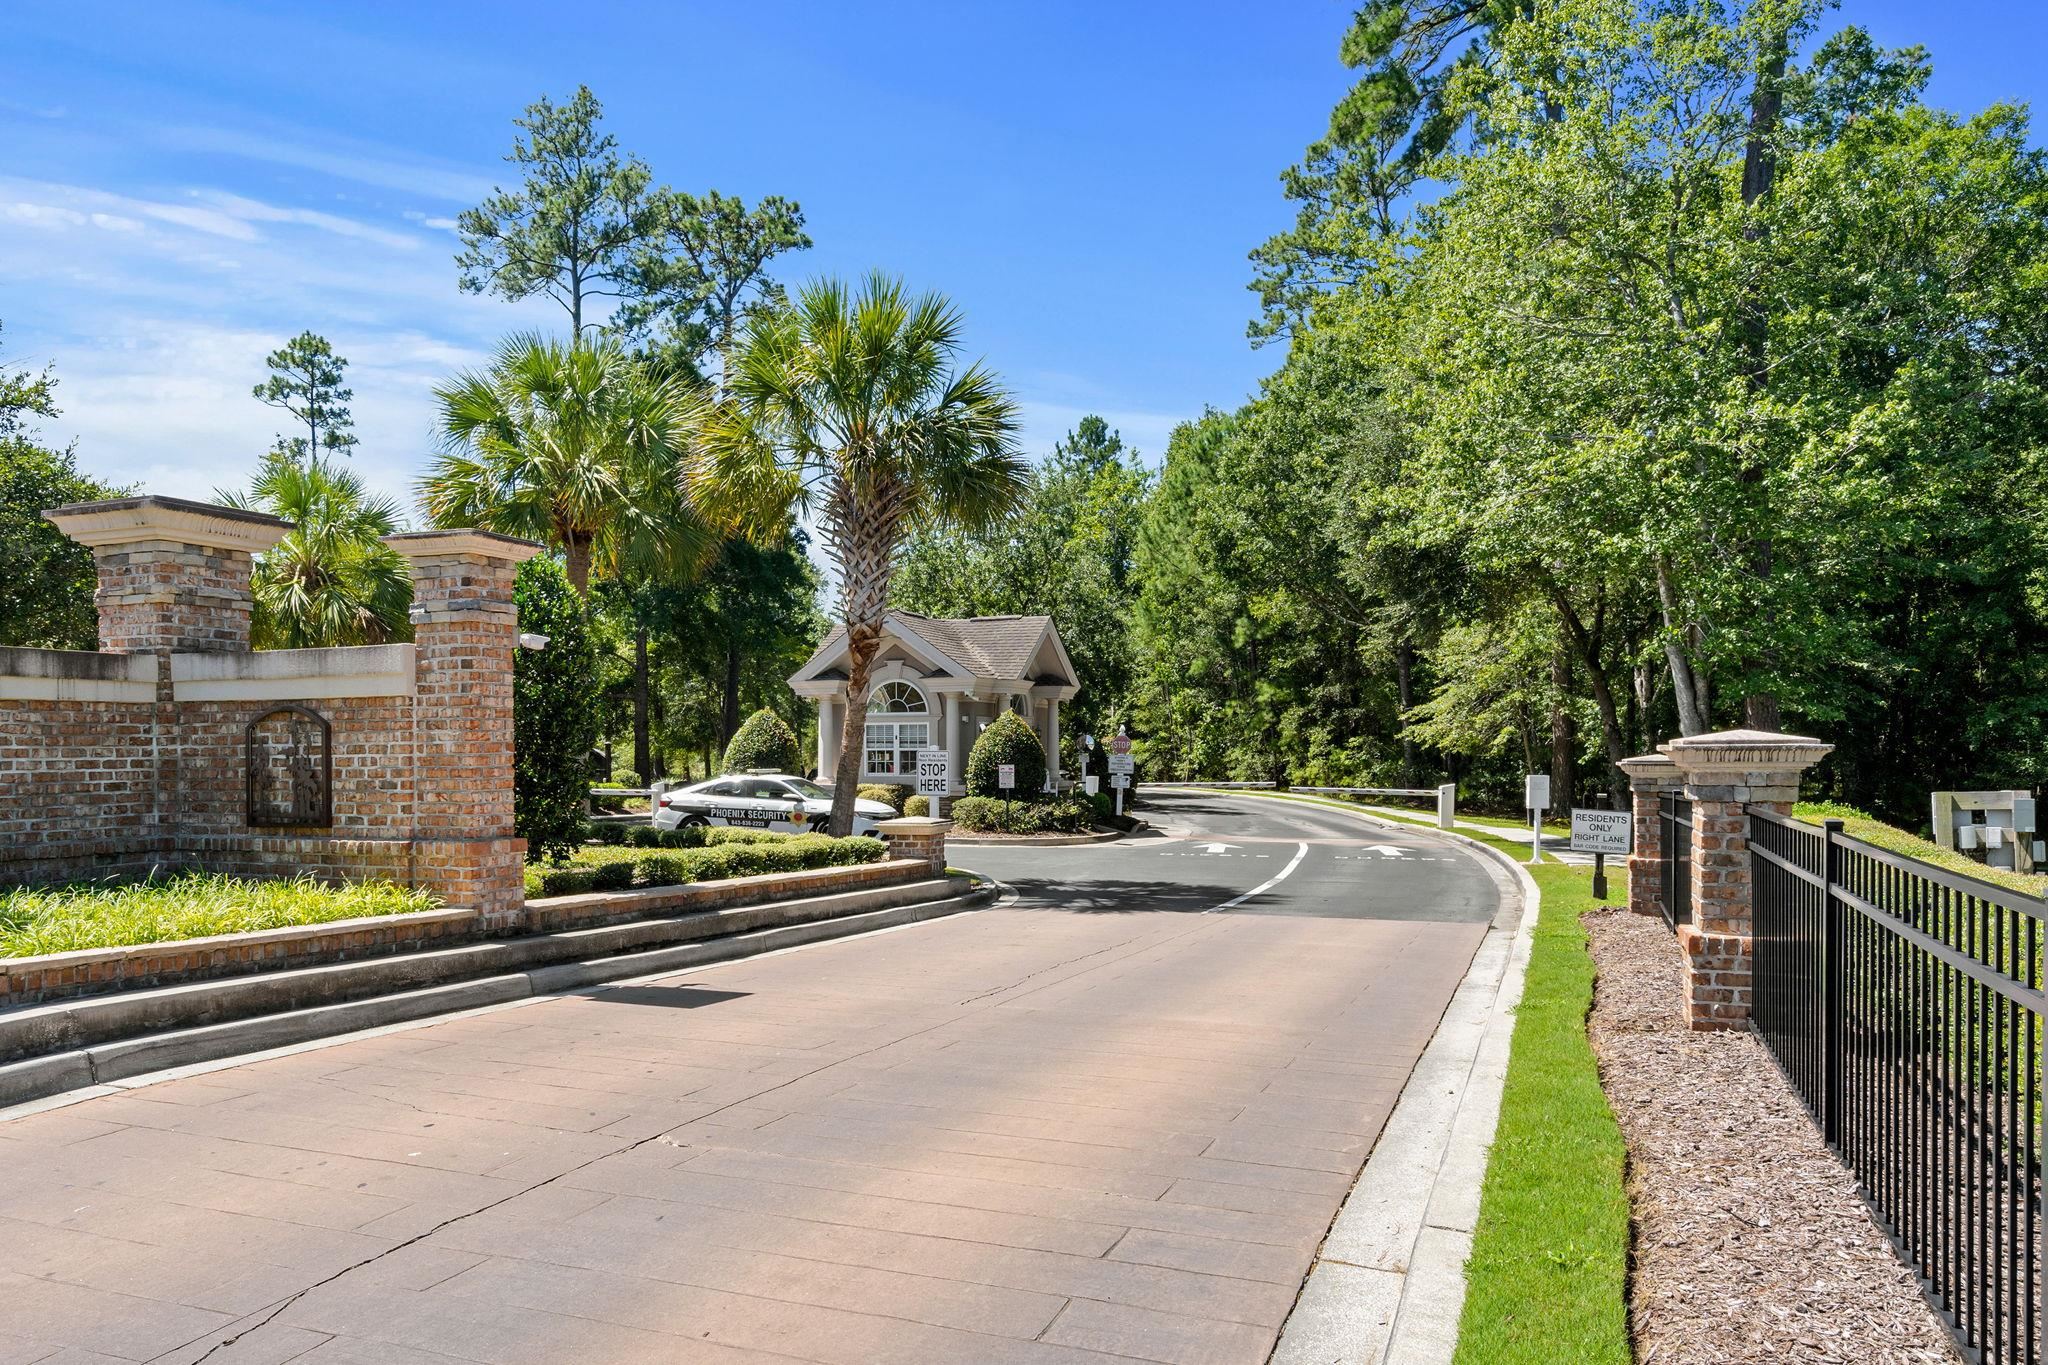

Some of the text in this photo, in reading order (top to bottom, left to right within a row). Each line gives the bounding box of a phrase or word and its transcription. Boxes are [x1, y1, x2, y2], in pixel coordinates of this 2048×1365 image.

[1113, 741, 1130, 749] STOP
[920, 763, 946, 776] STOP
[920, 779, 946, 792] HERE
[711, 808, 787, 820] PHOENIX SECURITY
[1575, 813, 1627, 824] RESIDENTS
[1589, 823, 1612, 832] ONLY
[1574, 834, 1599, 842] RIGHT
